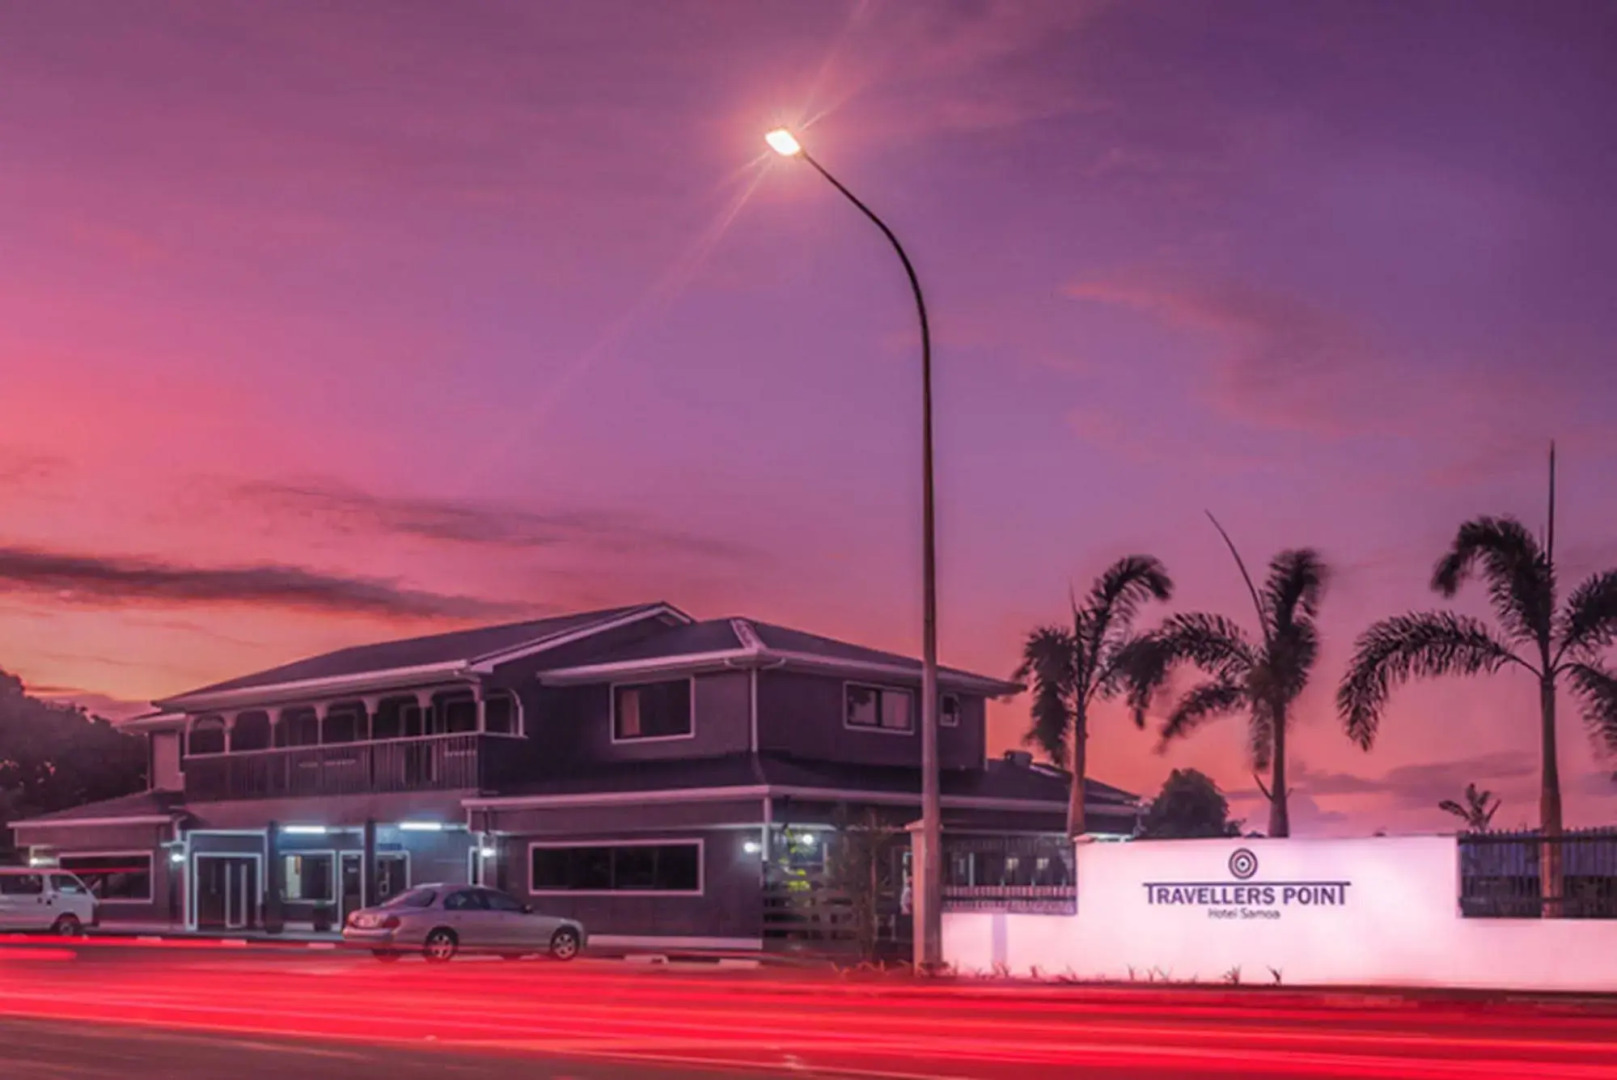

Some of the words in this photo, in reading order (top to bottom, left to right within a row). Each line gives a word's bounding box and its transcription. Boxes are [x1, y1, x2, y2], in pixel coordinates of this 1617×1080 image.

[1143, 882, 1276, 905] TRAVELLERS
[1282, 882, 1350, 905] POINT
[1208, 908, 1238, 919] Hotel
[1240, 908, 1281, 919] Samoa
